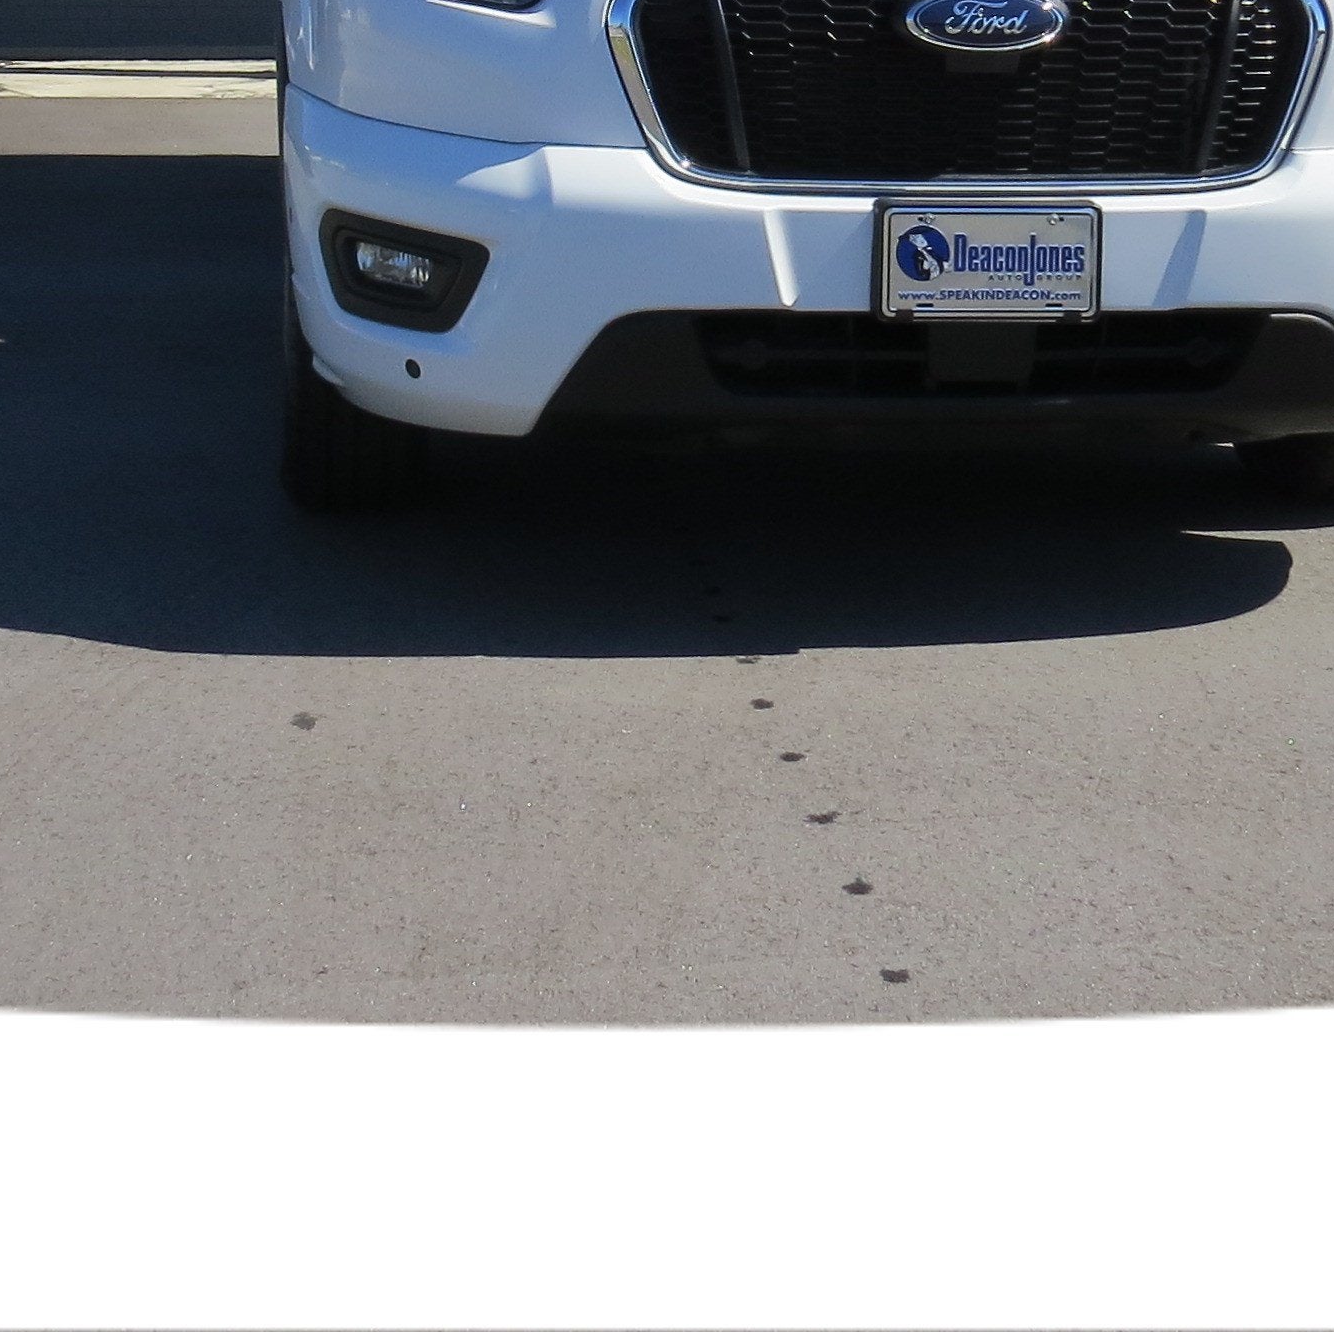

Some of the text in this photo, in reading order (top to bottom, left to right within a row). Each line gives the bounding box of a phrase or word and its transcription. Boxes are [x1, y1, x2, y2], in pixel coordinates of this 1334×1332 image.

[944, 0, 1029, 34] Ford
[988, 273, 1082, 281] AUTO GROUP
[897, 289, 1082, 301] www.SPEAKINDEACON.com
